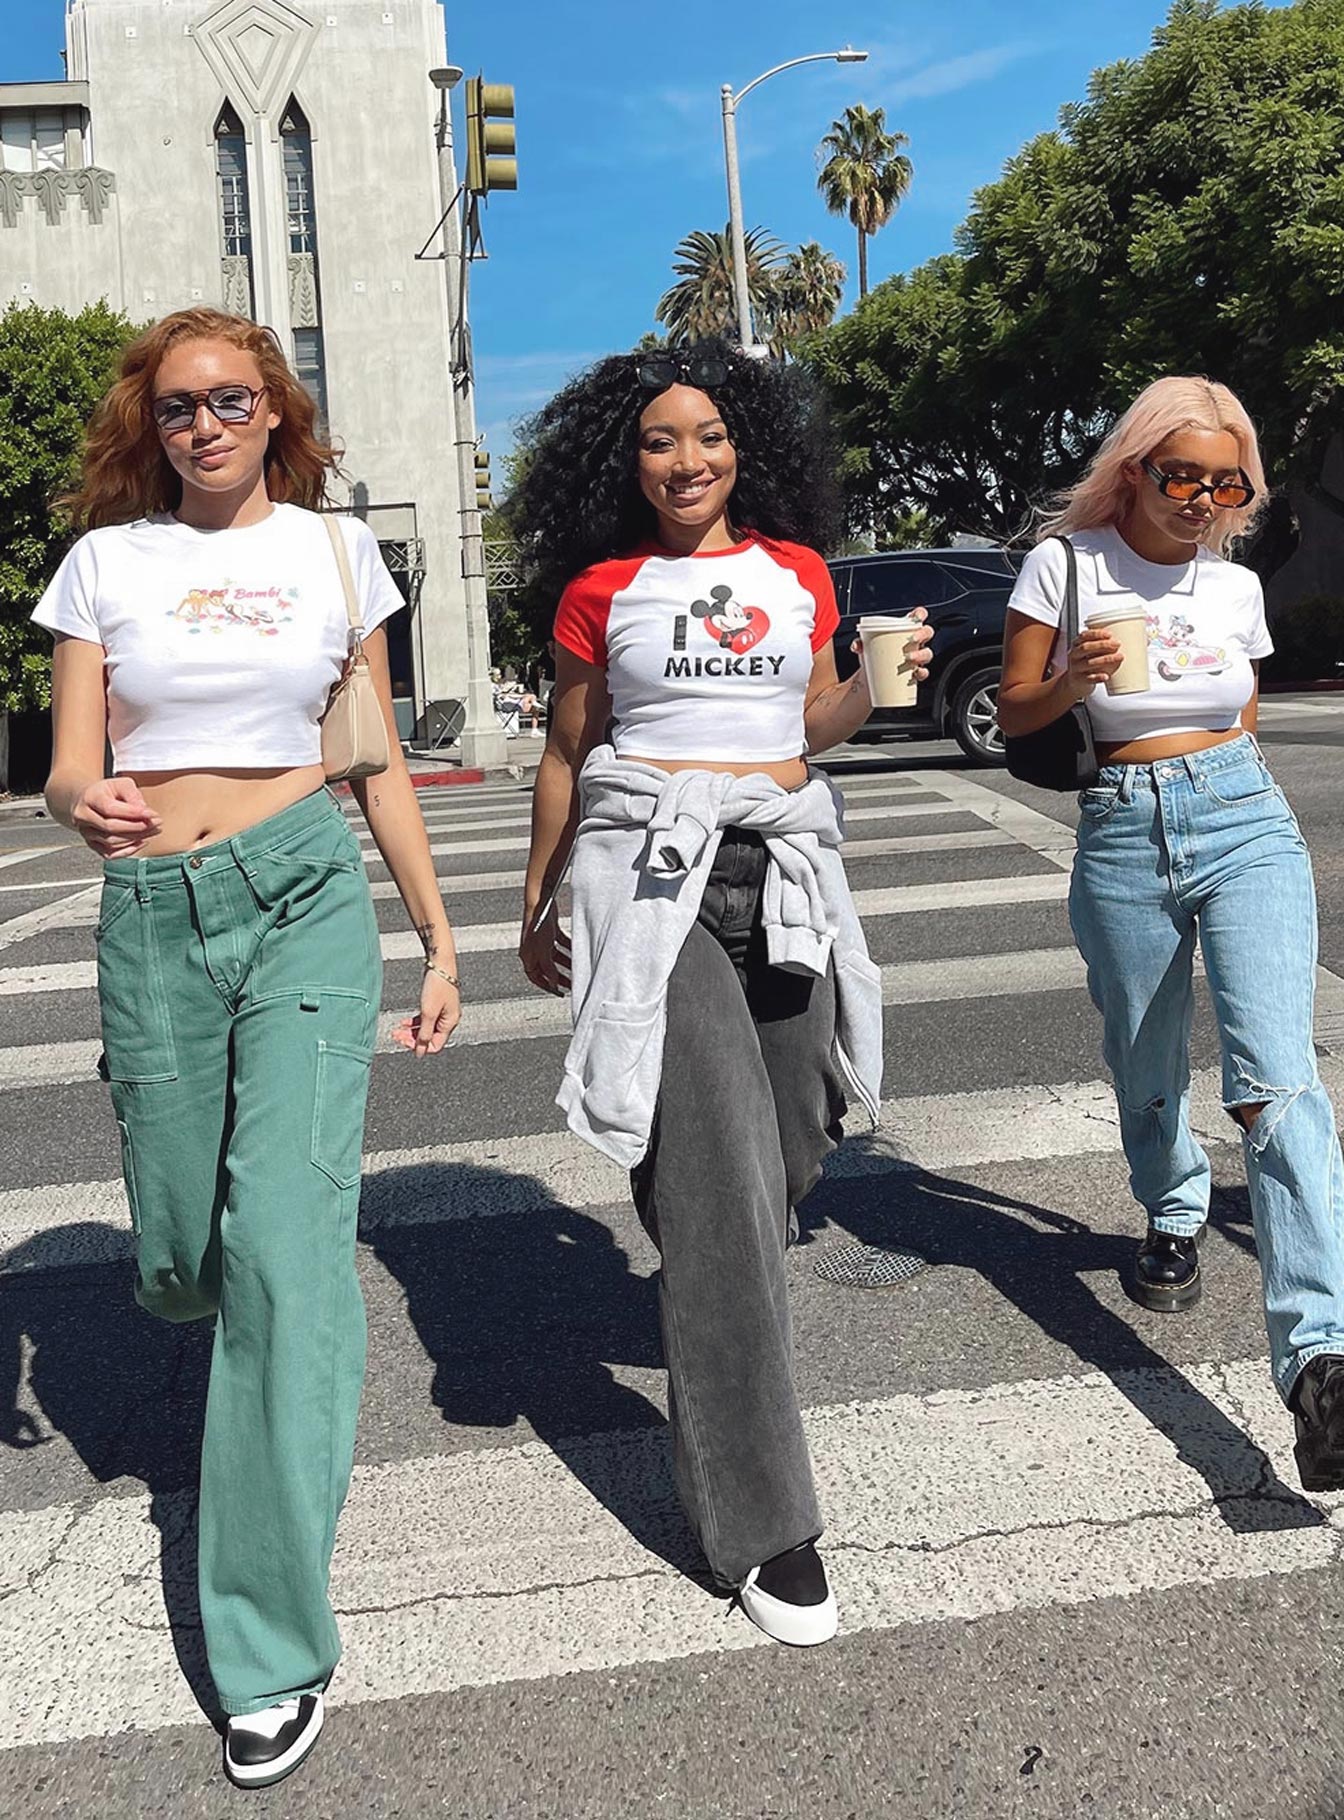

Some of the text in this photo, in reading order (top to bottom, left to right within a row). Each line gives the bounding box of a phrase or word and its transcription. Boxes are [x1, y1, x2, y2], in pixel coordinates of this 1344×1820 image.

[233, 586, 281, 599] Bambi
[673, 615, 687, 650] I
[664, 655, 786, 677] MICKEY
